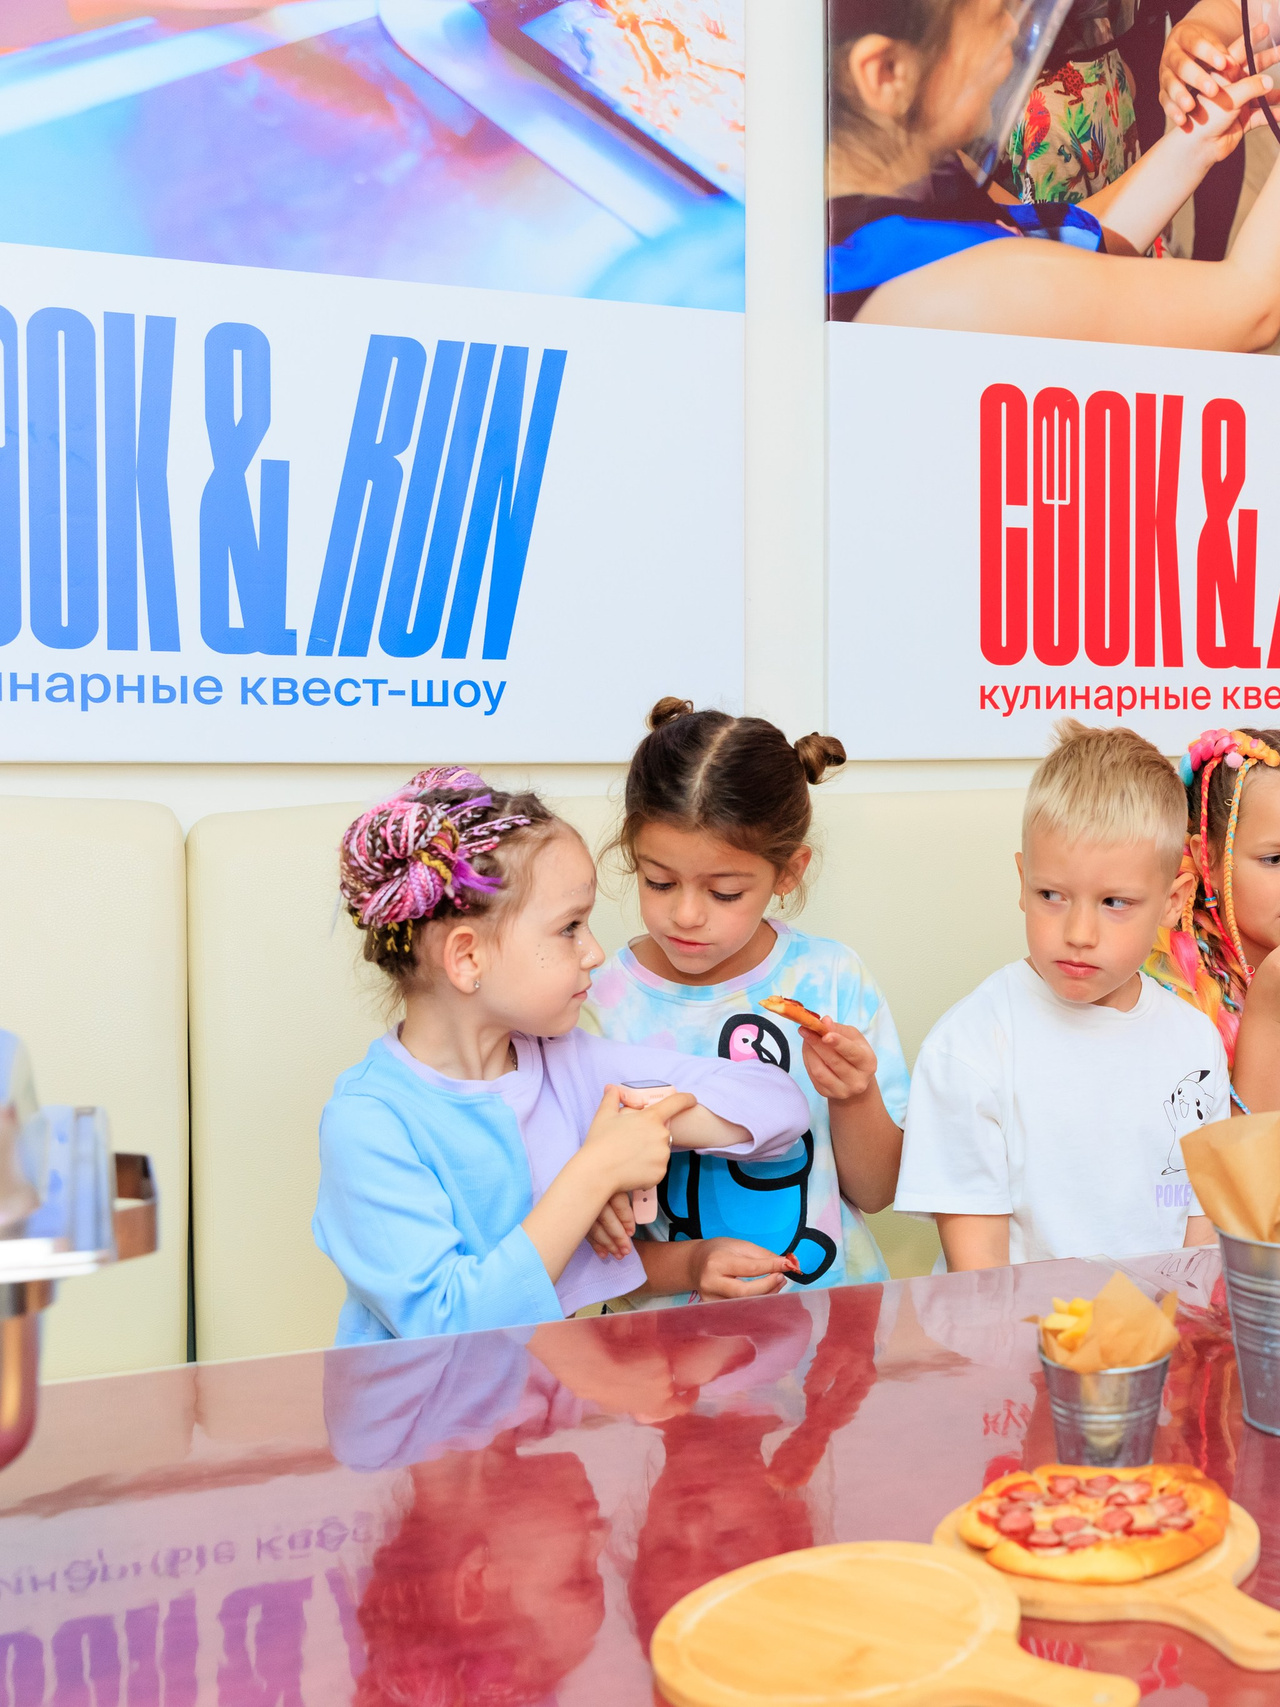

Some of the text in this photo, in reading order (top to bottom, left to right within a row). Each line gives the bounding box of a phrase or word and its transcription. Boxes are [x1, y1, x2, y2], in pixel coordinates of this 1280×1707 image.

[199, 321, 297, 657] &
[305, 333, 569, 661] RUN
[979, 382, 1185, 668] COOK
[1195, 397, 1262, 670] &
[0, 671, 508, 717] нарные квест-шоу
[979, 684, 1212, 718] кулинарные
